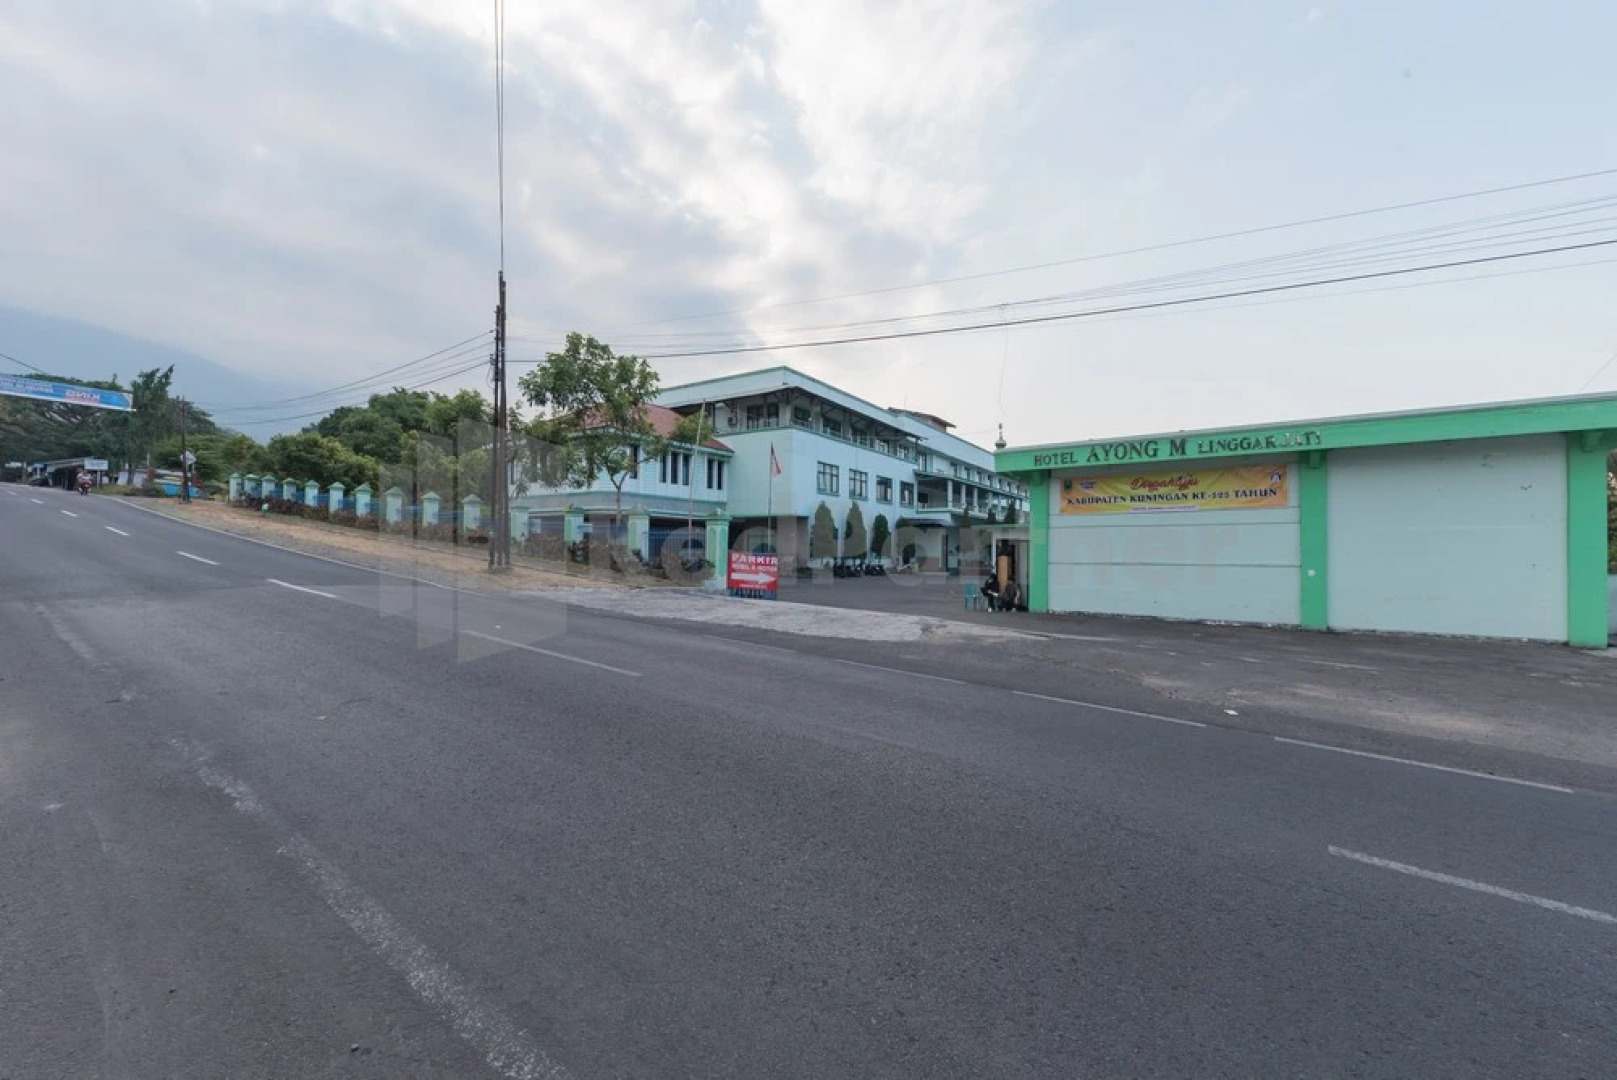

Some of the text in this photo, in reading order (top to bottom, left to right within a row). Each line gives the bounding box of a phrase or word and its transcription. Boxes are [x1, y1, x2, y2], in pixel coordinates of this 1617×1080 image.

[1034, 452, 1078, 466] HOTEL
[1086, 440, 1160, 462] AYONG
[1169, 439, 1187, 456] M
[1067, 495, 1127, 505] KABUPATEN
[1130, 492, 1188, 502] KUNINGAN
[1234, 488, 1277, 498] TAHUN
[731, 553, 778, 564] PARKIR
